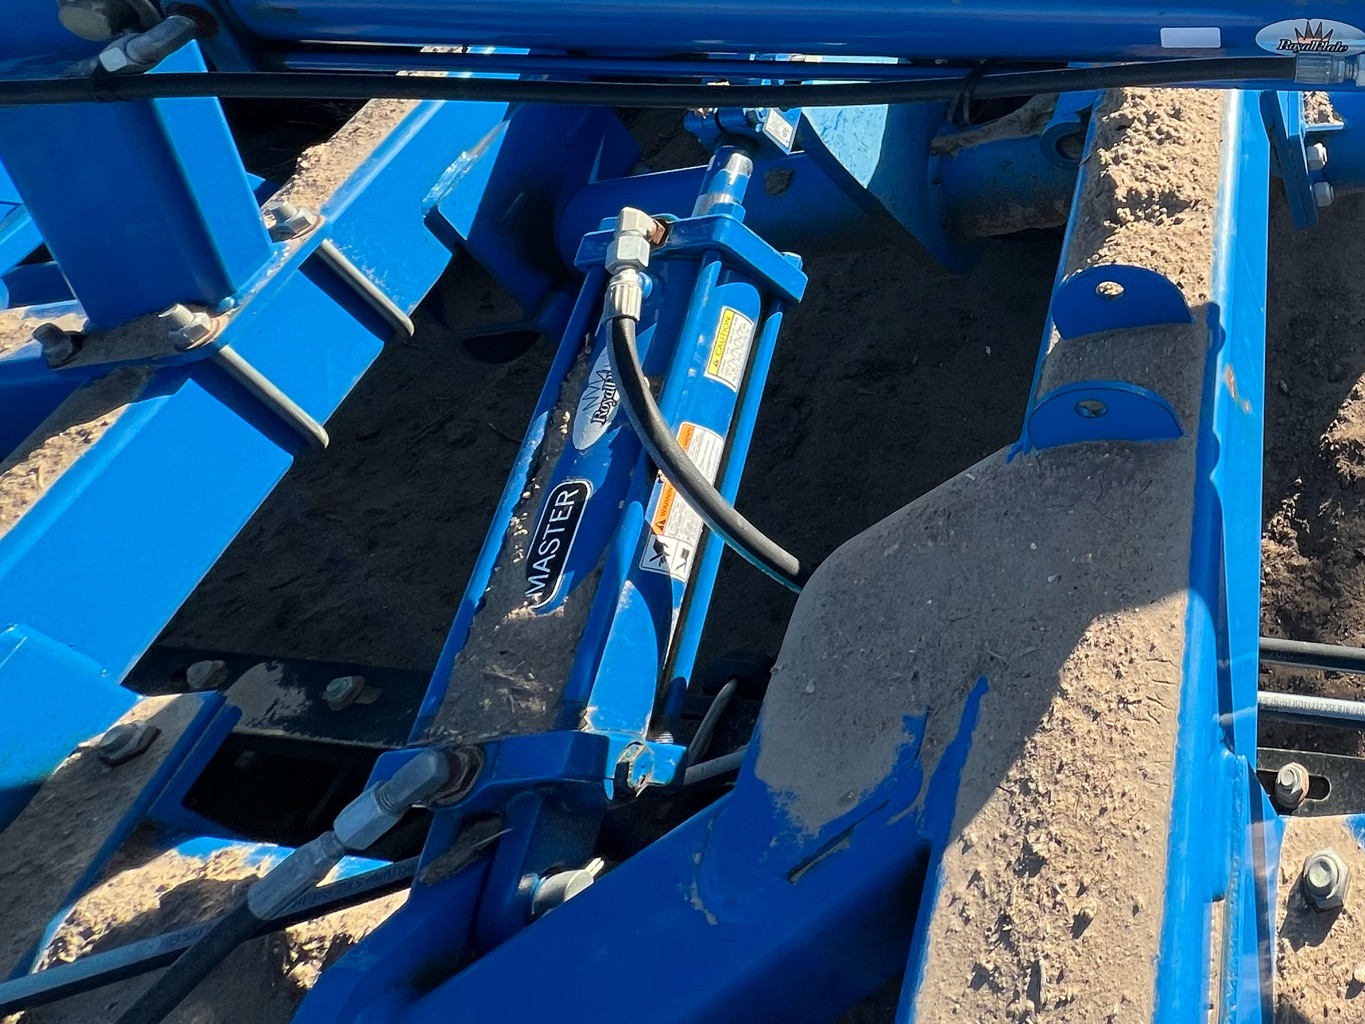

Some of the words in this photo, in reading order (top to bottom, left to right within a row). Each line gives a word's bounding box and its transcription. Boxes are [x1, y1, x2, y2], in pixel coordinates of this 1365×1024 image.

[1276, 38, 1349, 54] RoyalPlate
[714, 315, 732, 358] CAUTION
[659, 485, 674, 517] WARNIN
[525, 488, 580, 598] MASTER
